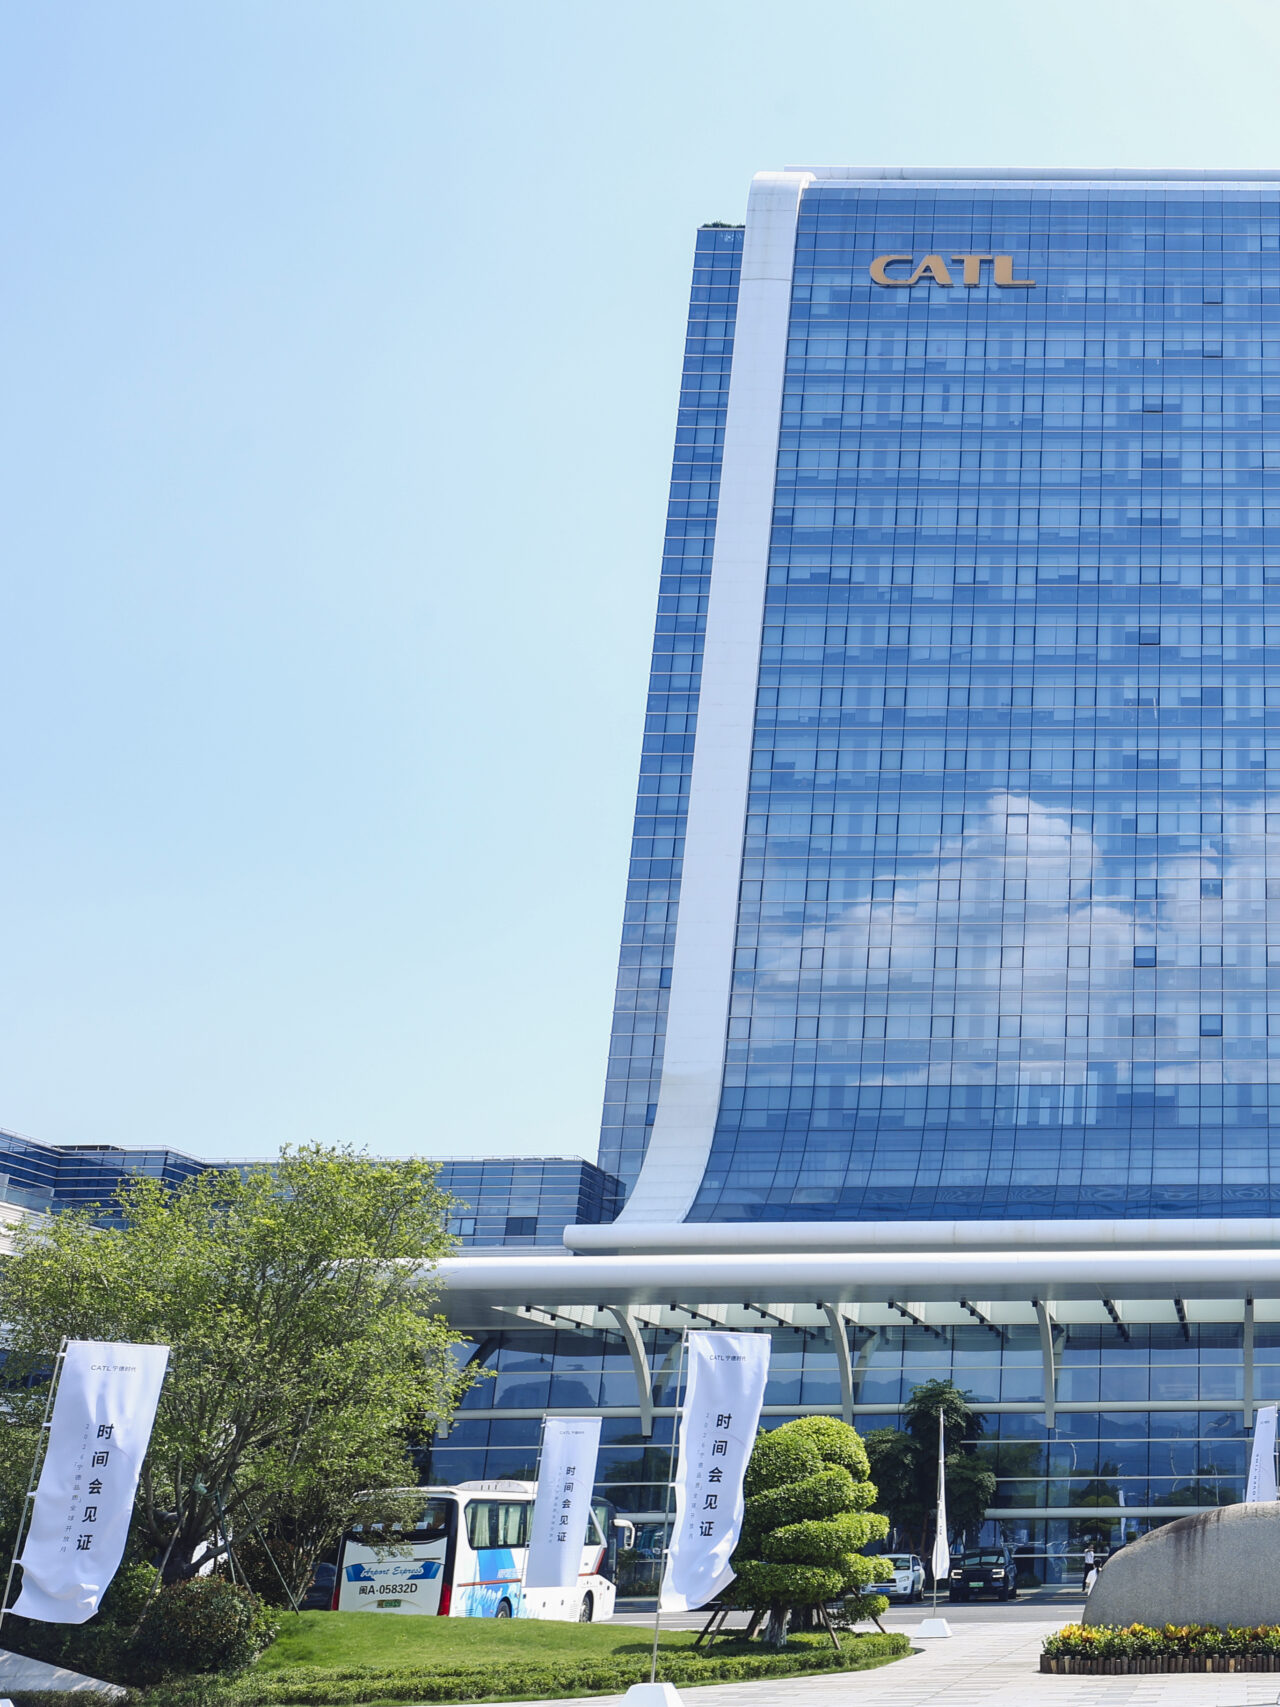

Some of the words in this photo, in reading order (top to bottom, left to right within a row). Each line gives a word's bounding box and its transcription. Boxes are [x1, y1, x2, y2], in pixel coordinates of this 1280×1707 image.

[869, 254, 1036, 287] CATL
[76, 1423, 114, 1551] 时间会见证
[557, 1466, 576, 1542] 时间会见证
[699, 1413, 732, 1537] 时间会见证
[392, 1566, 423, 1576] Express
